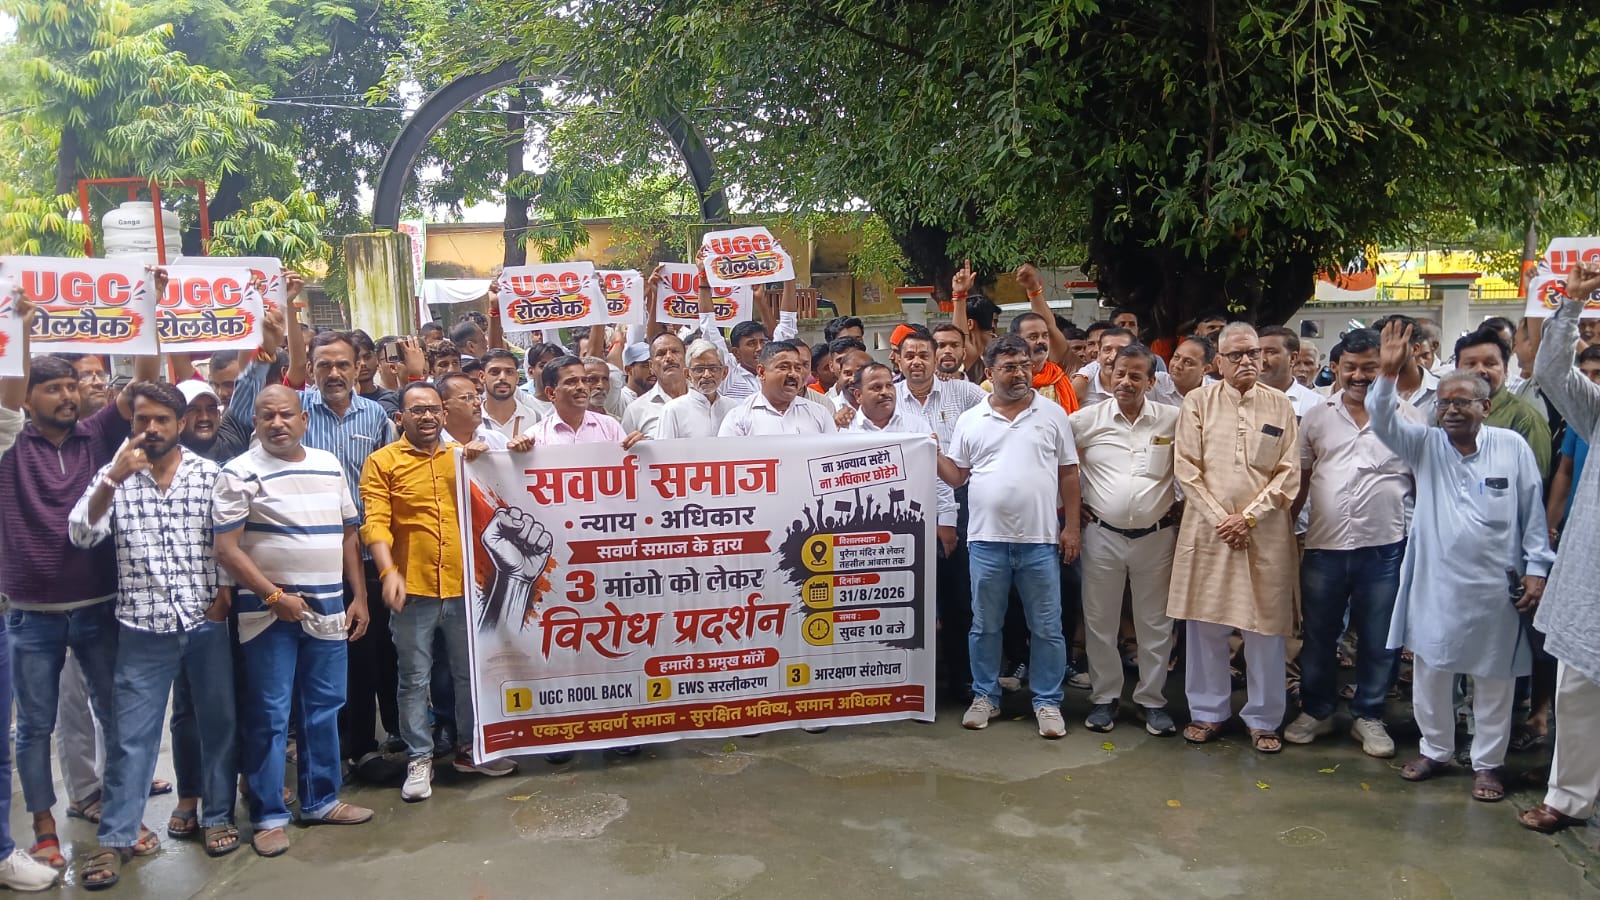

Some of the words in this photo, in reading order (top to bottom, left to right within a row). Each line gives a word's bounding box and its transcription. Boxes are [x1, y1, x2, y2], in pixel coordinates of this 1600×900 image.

[710, 234, 771, 255] UGC
[718, 253, 777, 275] रोलबैक
[22, 270, 131, 305] UGC
[158, 277, 243, 308] UGC
[511, 272, 582, 297] UGC
[516, 297, 583, 319] रोलबैक
[158, 310, 246, 337] रोलबैक
[821, 462, 834, 473] ना
[836, 456, 867, 471] अन्याय
[524, 455, 639, 505] सवर्ण
[649, 458, 779, 499] समाज
[819, 478, 832, 489] ना
[834, 471, 871, 487] अधिकार
[579, 513, 637, 533] न्याय
[661, 503, 756, 529] अधिकार
[597, 540, 638, 559] सवर्ण
[641, 541, 688, 557] समाज
[692, 536, 708, 553] के
[860, 547, 876, 557] मंदिर
[886, 546, 905, 555] लेकर
[892, 557, 906, 565] तक
[565, 570, 596, 602] 3
[603, 569, 663, 597] मांगो
[669, 566, 700, 592] को
[705, 565, 765, 590] लेकर
[840, 586, 905, 602] 31/8/2026
[538, 601, 667, 662] विरोध
[672, 593, 792, 647] प्रदर्शन
[839, 626, 866, 641] सुबह
[869, 624, 882, 636] 10
[885, 620, 905, 634] बजे
[659, 656, 694, 673] हमारी
[697, 658, 705, 669] 3
[708, 655, 740, 671] प्रमुख
[791, 668, 801, 683] 3
[814, 666, 856, 681] आरक्षण
[859, 659, 902, 678] संशोधन
[512, 692, 521, 708] 1
[539, 688, 563, 706] UGC
[567, 686, 598, 703] ROOL
[602, 683, 633, 700] BACK
[652, 682, 662, 698] 2
[678, 680, 704, 695] EWS
[708, 676, 768, 693] सरलीकरण
[532, 721, 585, 741] एकजुट
[588, 715, 629, 733] सवर्ण
[632, 712, 676, 728] समाज
[690, 705, 742, 727] सुरक्षित
[795, 697, 834, 713] समान
[838, 691, 892, 710] अधिकार
